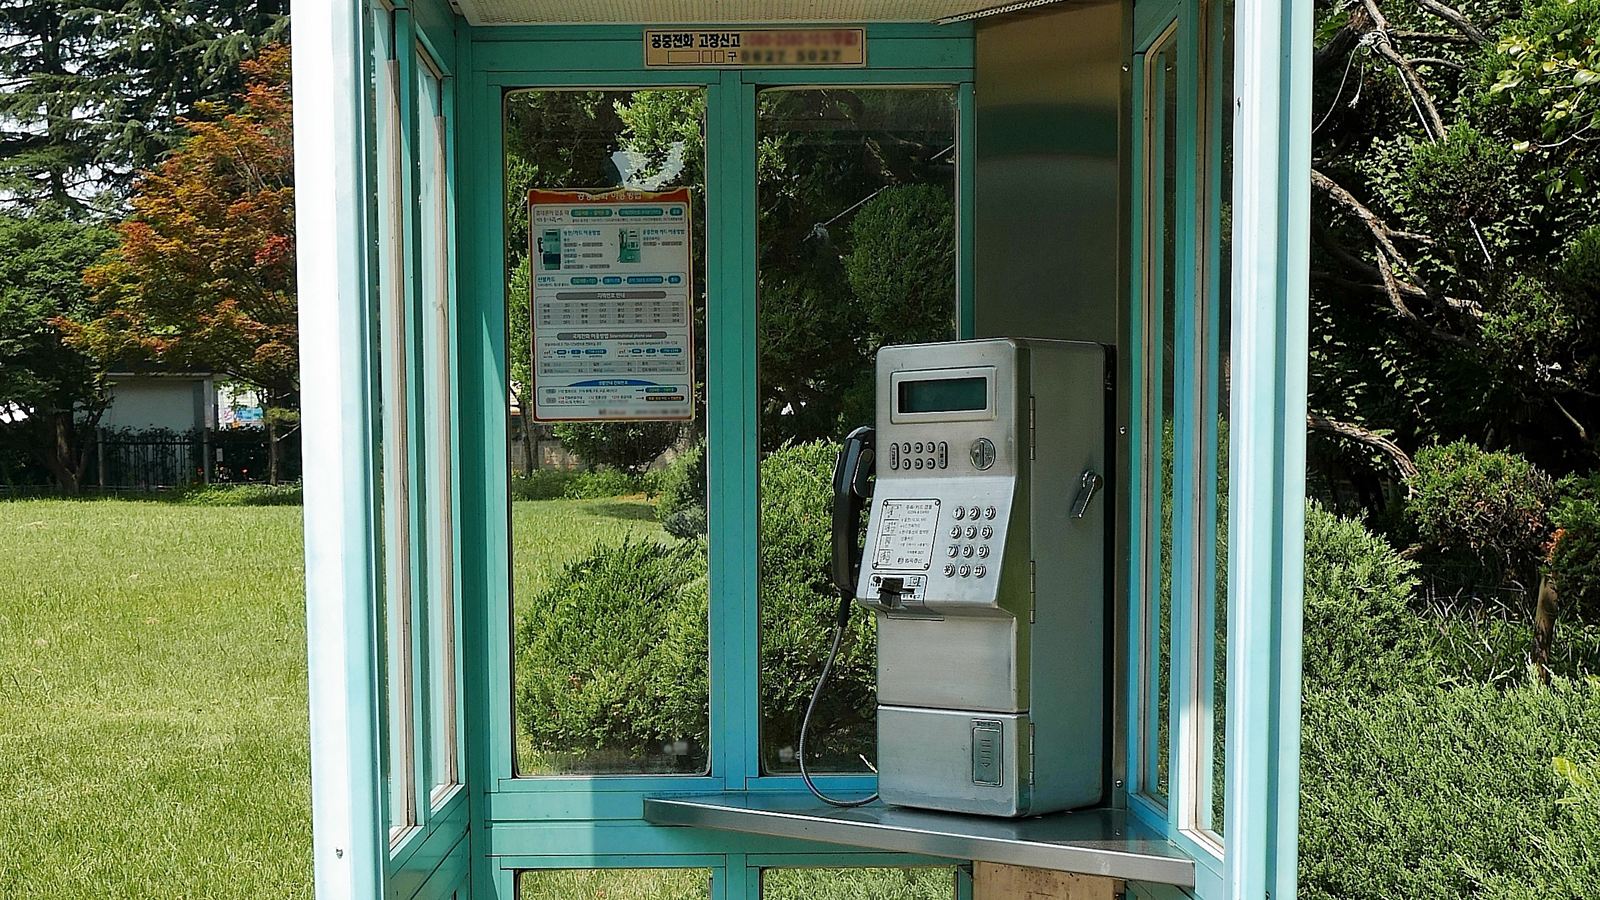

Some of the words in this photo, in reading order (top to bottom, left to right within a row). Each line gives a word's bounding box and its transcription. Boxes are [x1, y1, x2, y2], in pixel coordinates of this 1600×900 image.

[651, 33, 694, 48] 공중전화
[699, 33, 740, 48] 고장신고
[728, 51, 737, 62] 구
